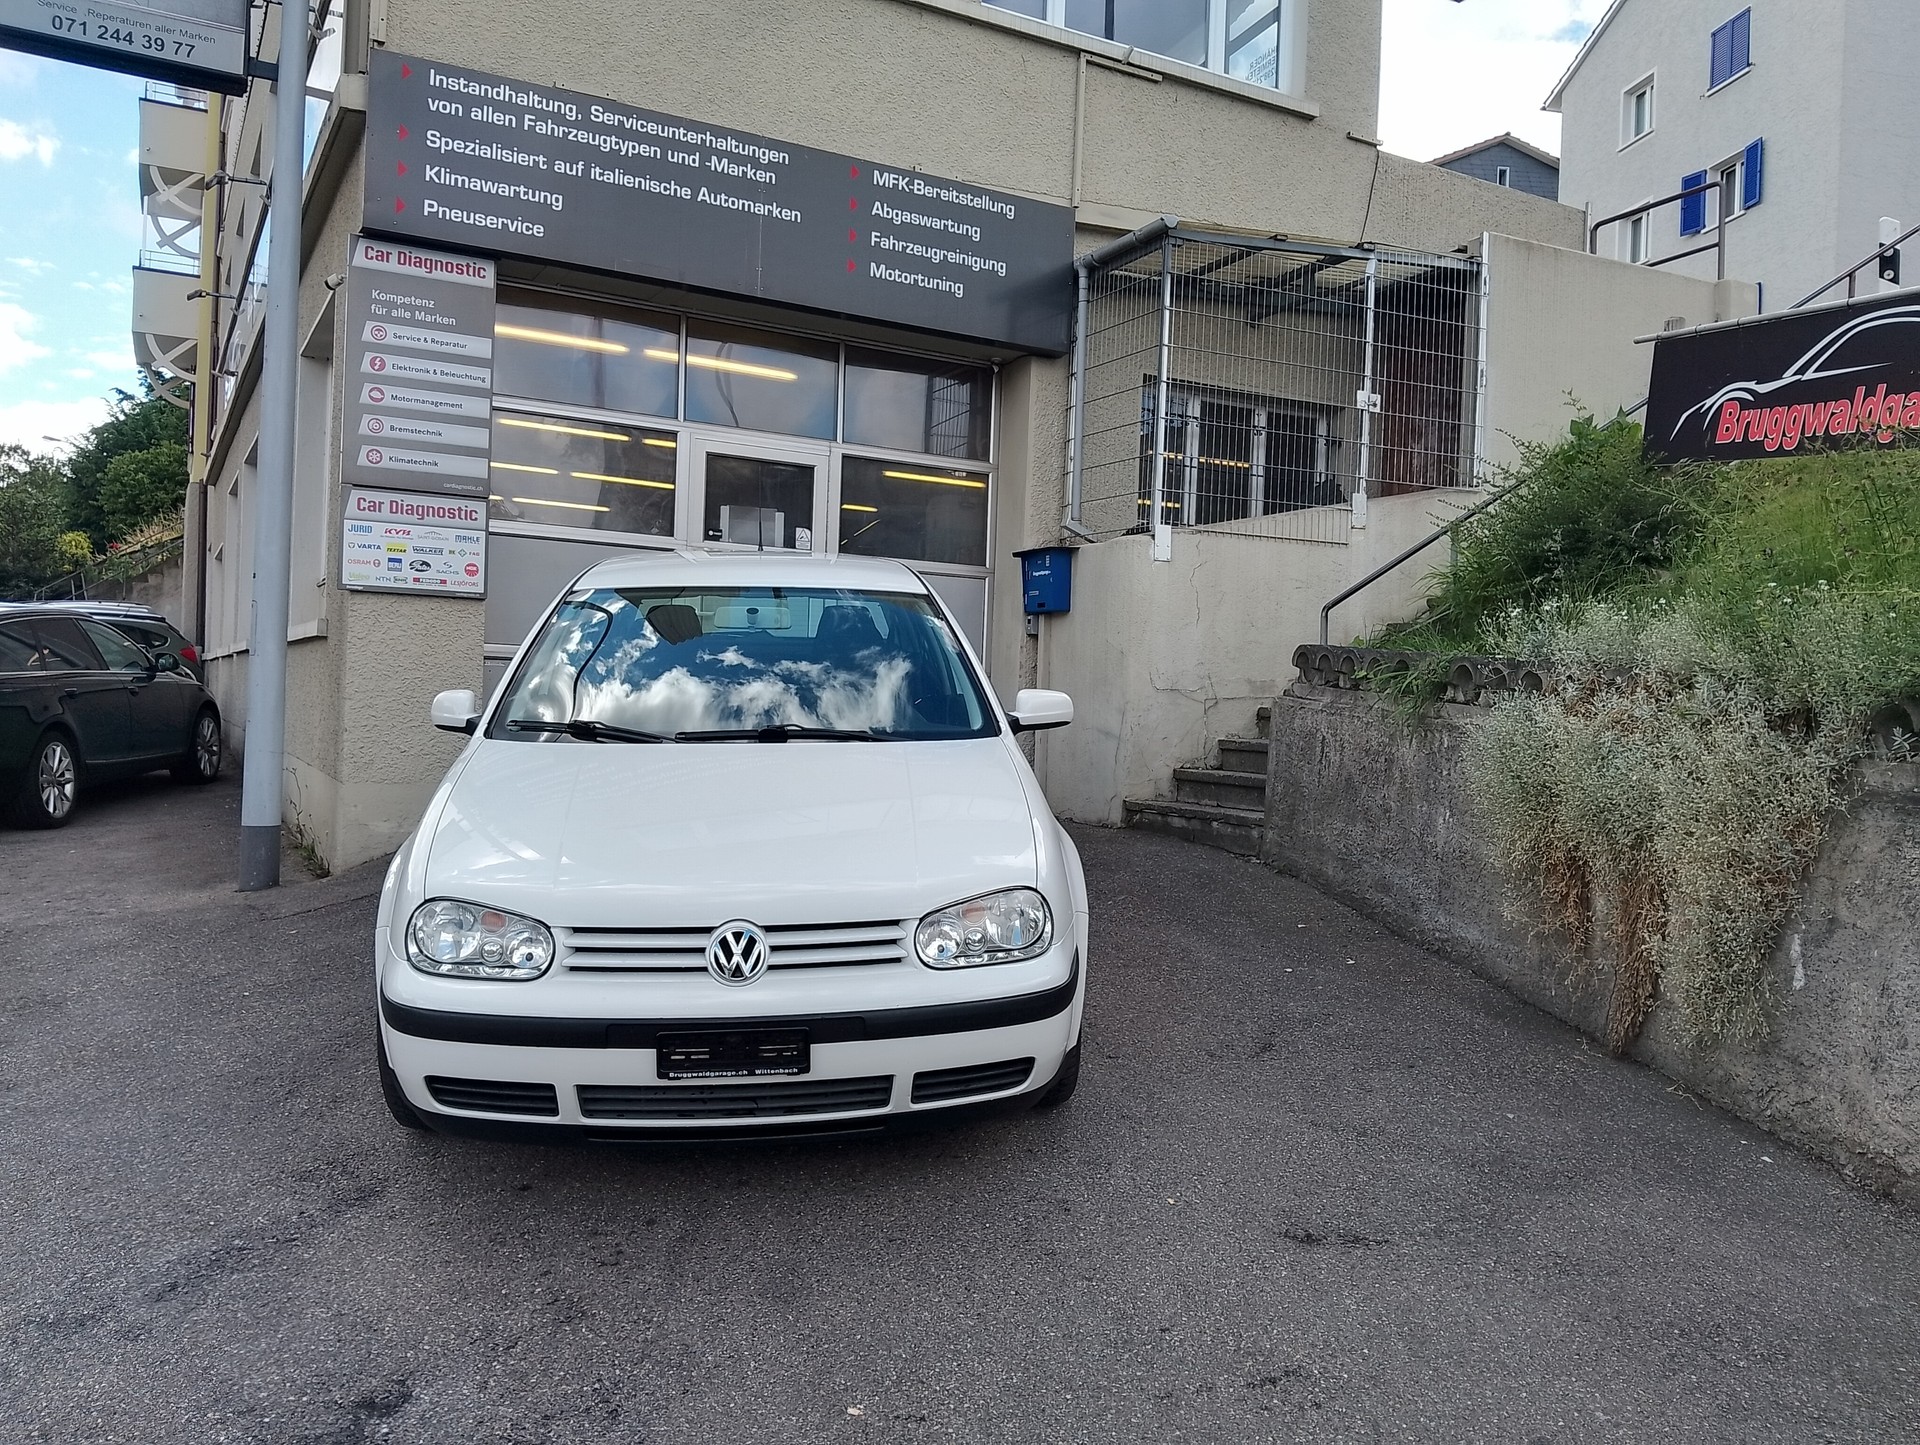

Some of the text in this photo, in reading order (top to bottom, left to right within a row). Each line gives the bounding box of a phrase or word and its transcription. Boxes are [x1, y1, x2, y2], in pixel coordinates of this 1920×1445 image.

[37, 0, 77, 13] Service
[155, 24, 177, 35] aller
[179, 28, 216, 44] Marken
[52, 14, 196, 58] 071 244 39 77
[428, 68, 790, 165] Instandhaltung, Serviceunterhaltungen
[427, 98, 777, 185] von allen Fahrzeugtypen und -Marken
[425, 164, 564, 211] Klimawartung
[426, 130, 802, 223] Spezialisiert auf italienische Automarken
[873, 169, 1016, 220] MFK-Bereitstellung
[423, 199, 545, 237] Pneuservice
[871, 201, 981, 242] Abgaswartung
[364, 245, 487, 279] Car Diagnostic
[870, 231, 1007, 277] Fahrzeugreinigung
[869, 262, 964, 298] Motortuning
[371, 289, 435, 308] Kompetenz
[371, 304, 456, 326] für alle Marken
[392, 332, 468, 350] Service & Reparatur
[391, 363, 486, 384] Elektronik & Beleuchtung
[390, 393, 463, 409] Motormanagement
[389, 424, 443, 437] Bremstechnik
[388, 455, 439, 468] Klimatechnik
[443, 483, 483, 491] cardiagnostic.ch
[357, 497, 479, 521] Car Diagnostic
[347, 524, 373, 534] JURID
[412, 546, 444, 555] WALKER
[669, 1067, 798, 1078] Bruggwaldgarage.ch Wittenbach
